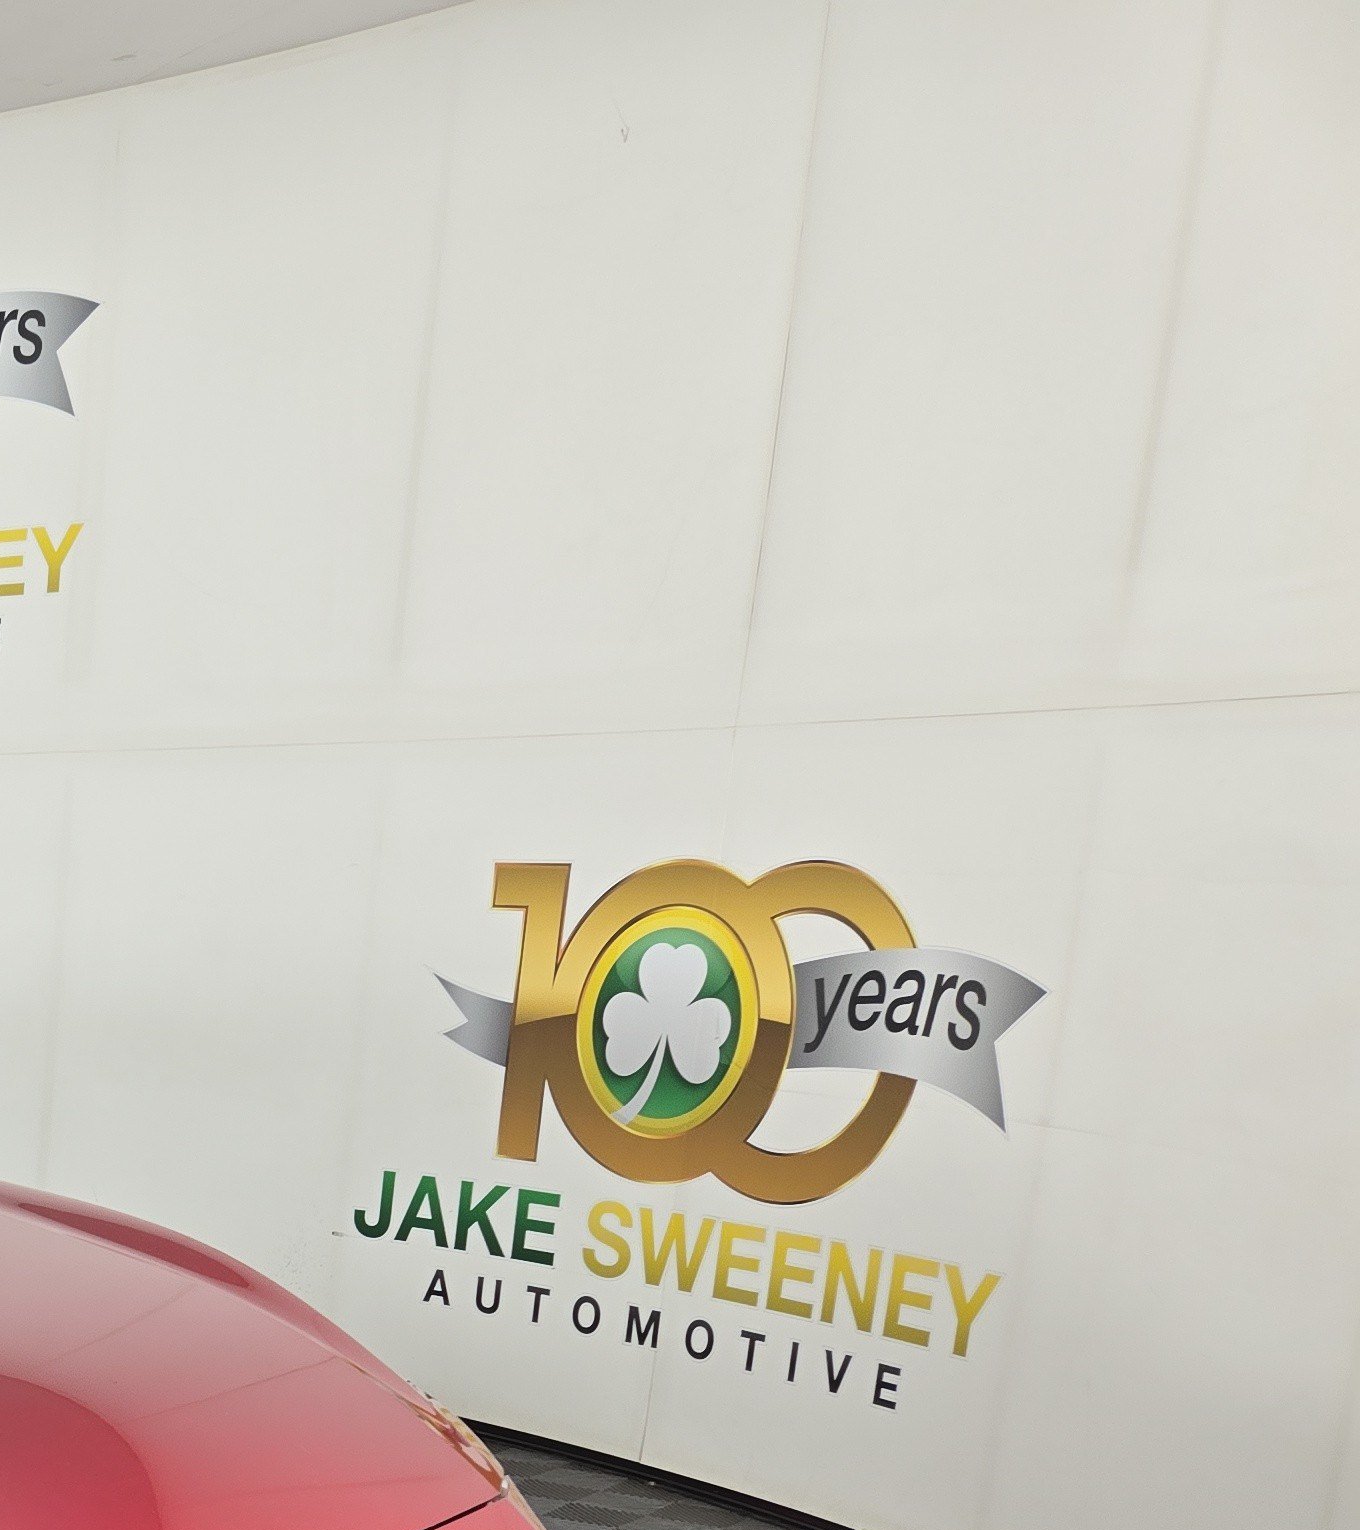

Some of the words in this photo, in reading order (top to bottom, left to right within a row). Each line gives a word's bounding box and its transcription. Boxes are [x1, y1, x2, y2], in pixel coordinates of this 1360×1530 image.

[491, 858, 918, 1206] 100
[803, 969, 987, 1055] years
[353, 1170, 562, 1267] JAKE
[581, 1200, 1001, 1358] SWEENEY
[423, 1269, 902, 1411] AUTOMOTIVE
